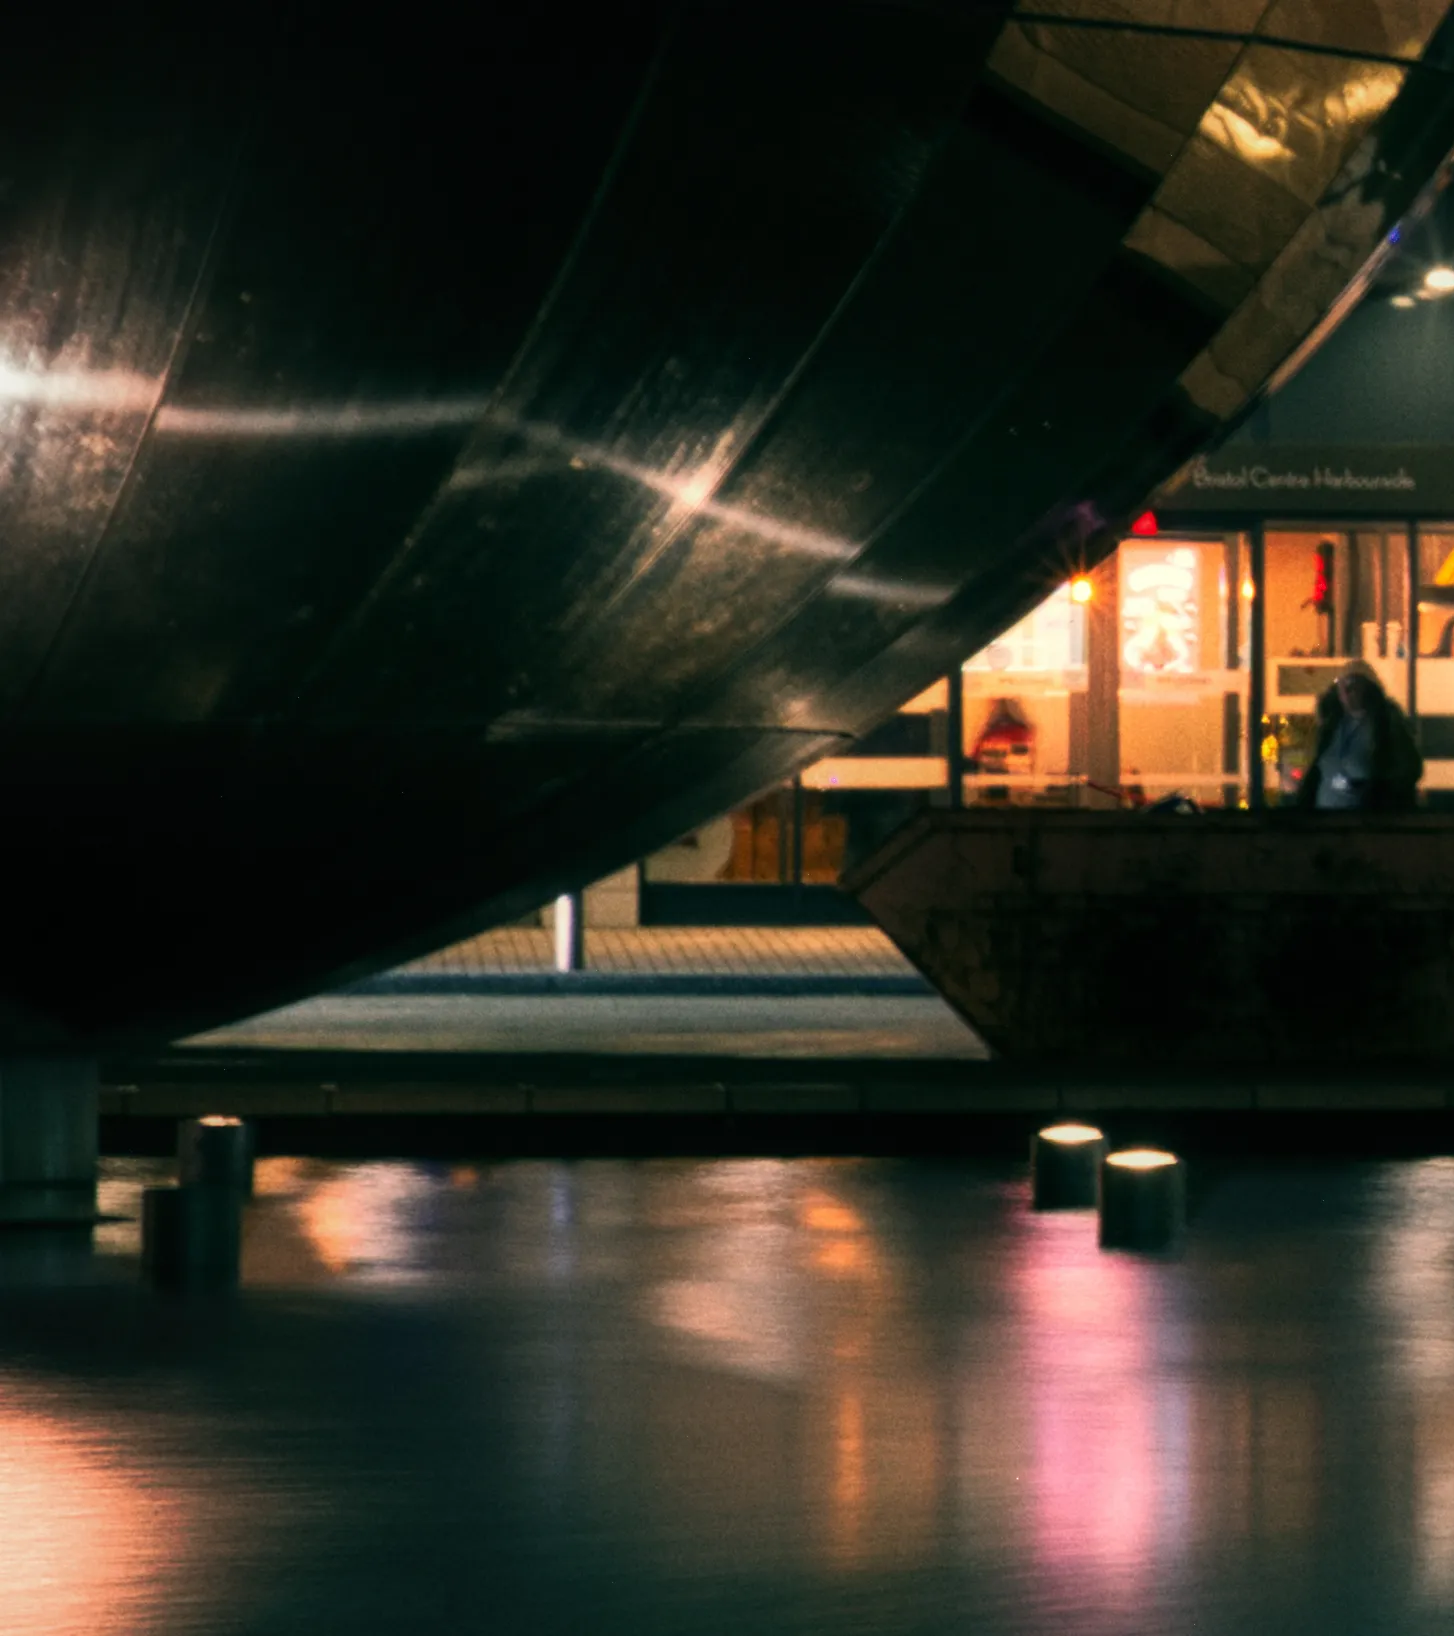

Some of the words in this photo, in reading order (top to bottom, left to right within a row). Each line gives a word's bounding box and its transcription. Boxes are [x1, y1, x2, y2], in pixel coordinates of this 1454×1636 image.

[1193, 466, 1248, 489] Bristol
[1250, 466, 1310, 489] Centre
[1313, 466, 1417, 490] Harbourside
